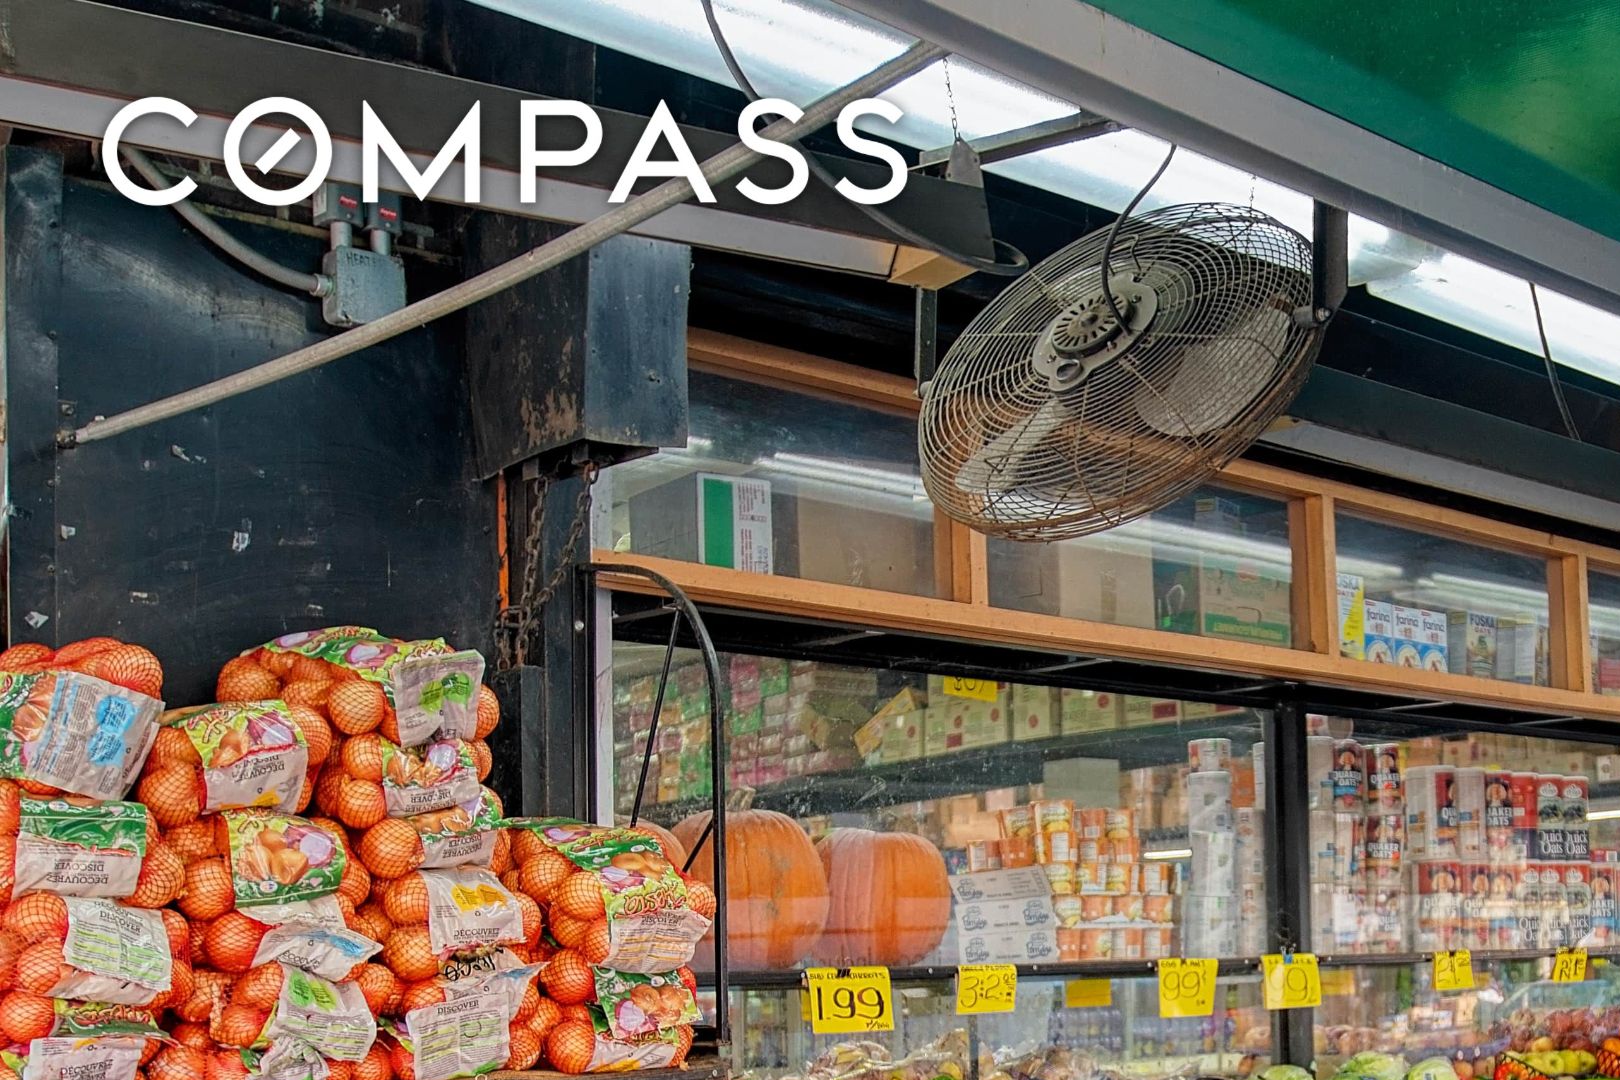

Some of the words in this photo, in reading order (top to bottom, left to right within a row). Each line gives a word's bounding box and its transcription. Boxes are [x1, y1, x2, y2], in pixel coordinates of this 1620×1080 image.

[1366, 607, 1391, 624] farina
[1396, 612, 1419, 628] farina
[1469, 612, 1495, 629] FOSKA
[1422, 617, 1445, 633] farina
[54, 862, 105, 872] DISCOVER
[437, 999, 479, 1015] DISCOVER
[816, 984, 885, 1020] 1.99
